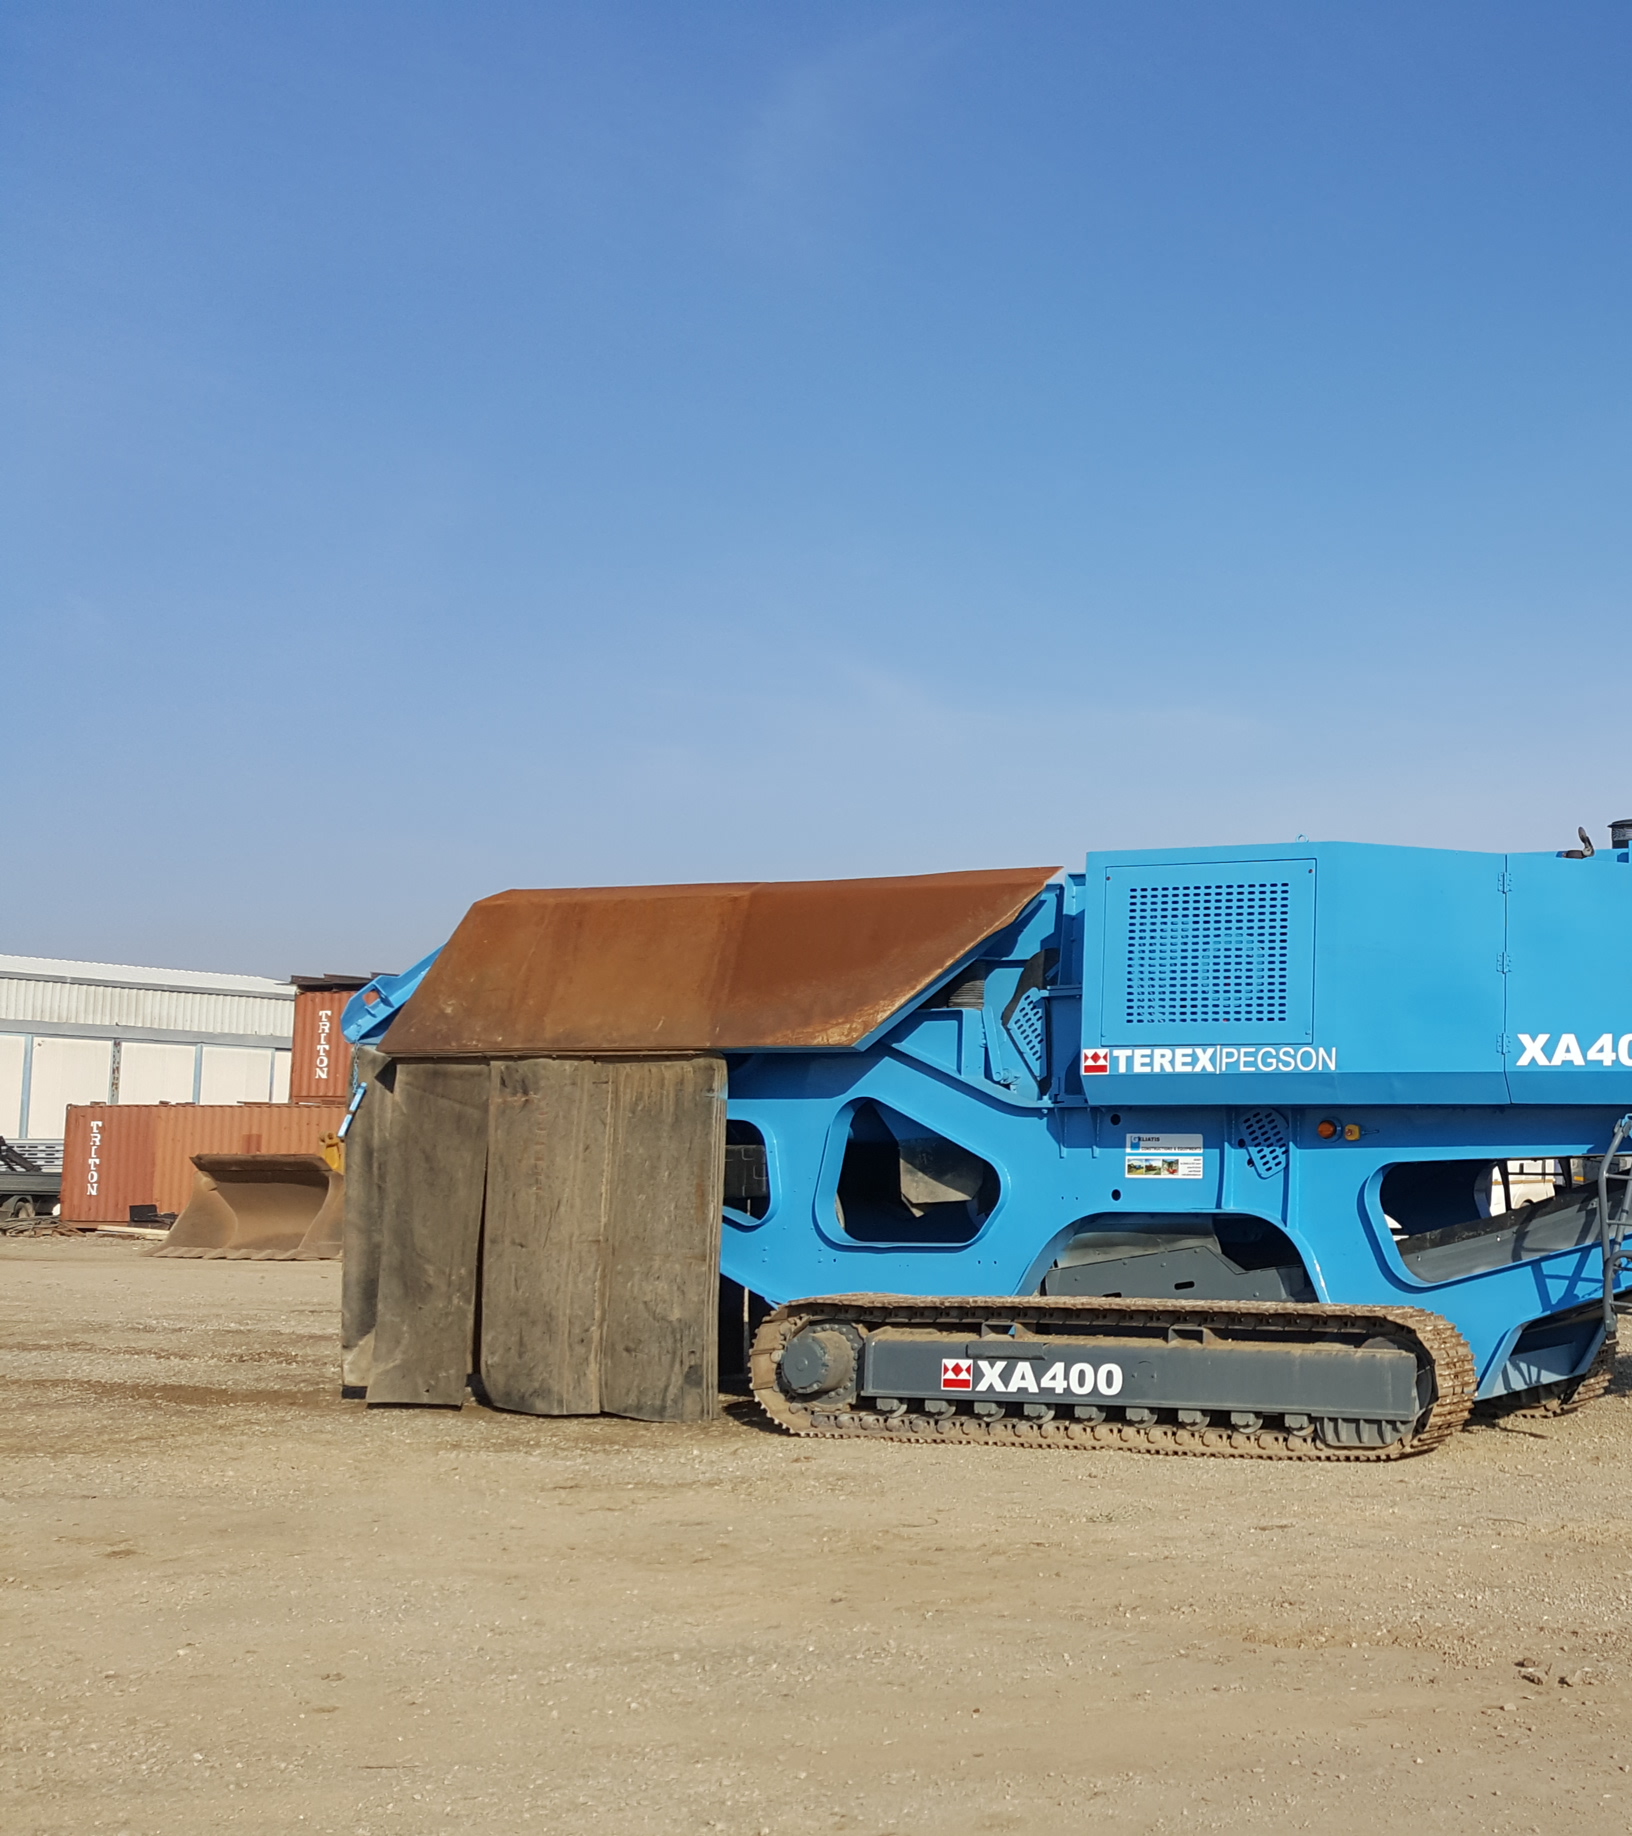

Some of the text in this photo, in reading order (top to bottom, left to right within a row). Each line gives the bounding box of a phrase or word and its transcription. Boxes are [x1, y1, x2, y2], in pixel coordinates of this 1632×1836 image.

[315, 1010, 332, 1079] TRITON
[1112, 1046, 1337, 1073] TEREX PEGSON
[86, 1120, 103, 1196] TRITON
[974, 1360, 1124, 1396] XA400
